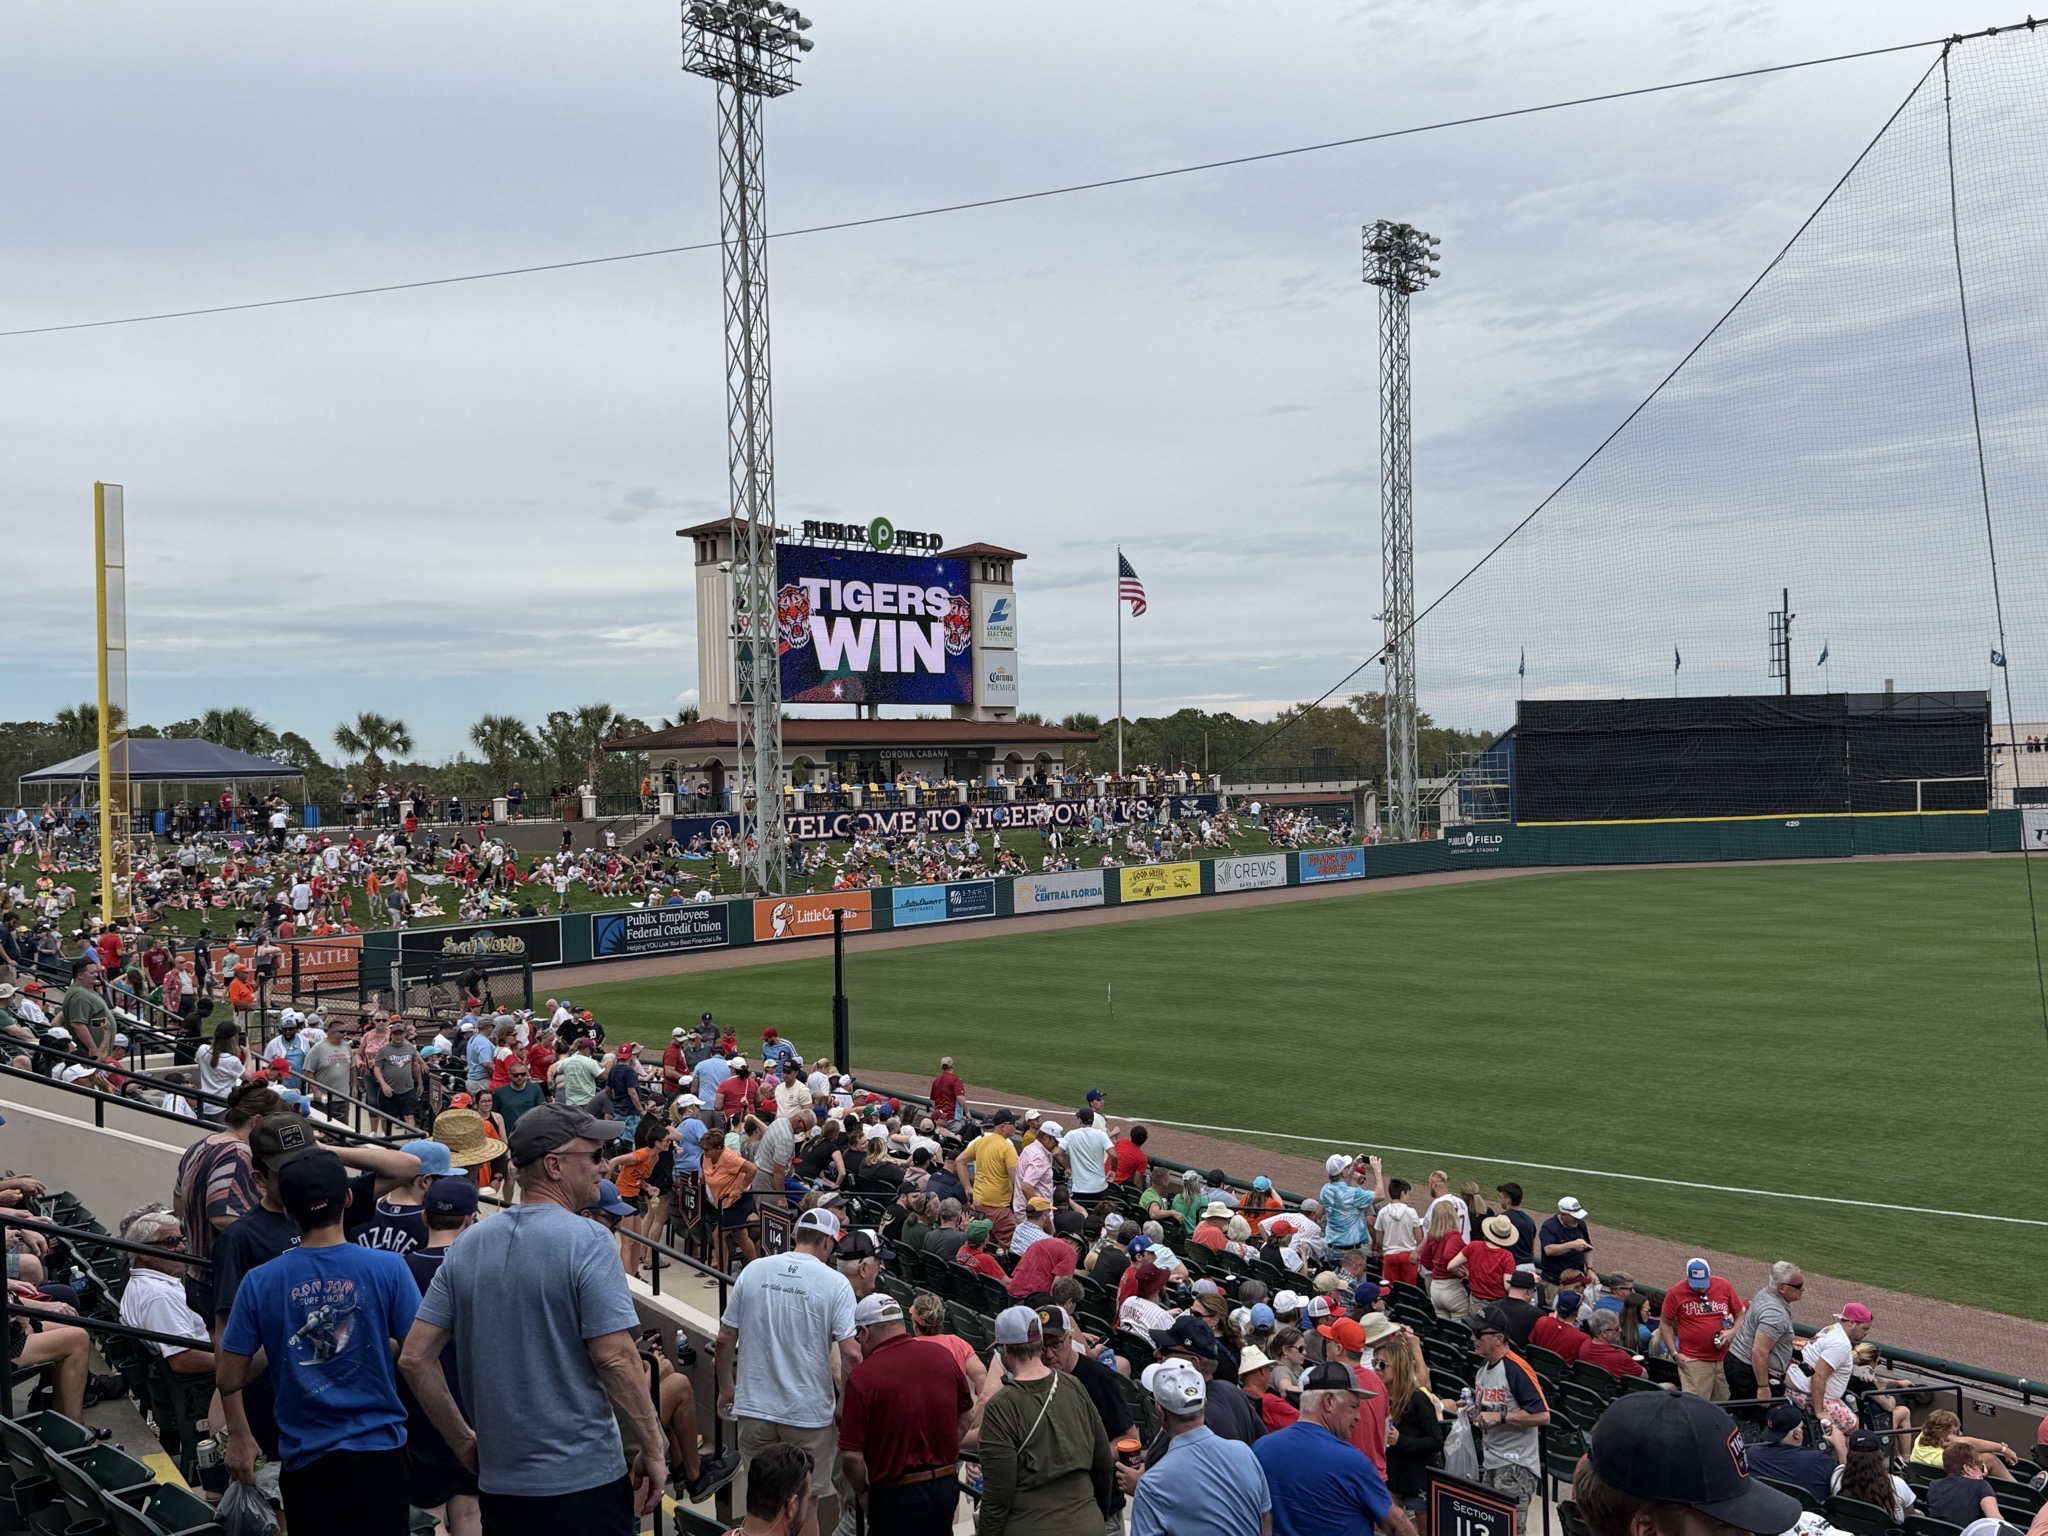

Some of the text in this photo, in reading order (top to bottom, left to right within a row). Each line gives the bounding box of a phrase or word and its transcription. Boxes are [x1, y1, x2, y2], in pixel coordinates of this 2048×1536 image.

[803, 520, 868, 542] PUBLIX
[896, 530, 944, 550] FIELD
[799, 577, 951, 617] TIGERS
[808, 616, 946, 674] WIN
[989, 672, 1013, 683] Corona
[986, 683, 1016, 692] PREMIER
[880, 750, 949, 759] CORONA CABANA
[928, 808, 960, 832] TO
[1447, 835, 1503, 846] PUBLIX FIELD
[1307, 850, 1357, 867] FRANK GAY
[1133, 870, 1147, 881] GOOD
[1234, 860, 1277, 879] CREWS
[1034, 886, 1103, 903] CENTRAL FLORIDA
[626, 910, 709, 926] Publix Employees
[797, 908, 822, 924] Little
[626, 921, 721, 940] Federal Credit Union
[626, 943, 647, 952] Helping
[646, 941, 659, 950] YOU
[659, 940, 669, 948] Live
[669, 939, 680, 947] Your
[681, 938, 692, 946] Best
[691, 936, 713, 945] Financial
[778, 1050, 787, 1060] P
[685, 1194, 695, 1210] 115
[768, 1219, 784, 1231] SECTION
[769, 1229, 782, 1247] 114
[291, 1280, 354, 1301] RON JON
[770, 1283, 782, 1291] ride
[782, 1286, 794, 1294] with
[794, 1287, 807, 1296] love
[299, 1294, 345, 1306] SURF SHOP
[1453, 1500, 1495, 1523] SECTION
